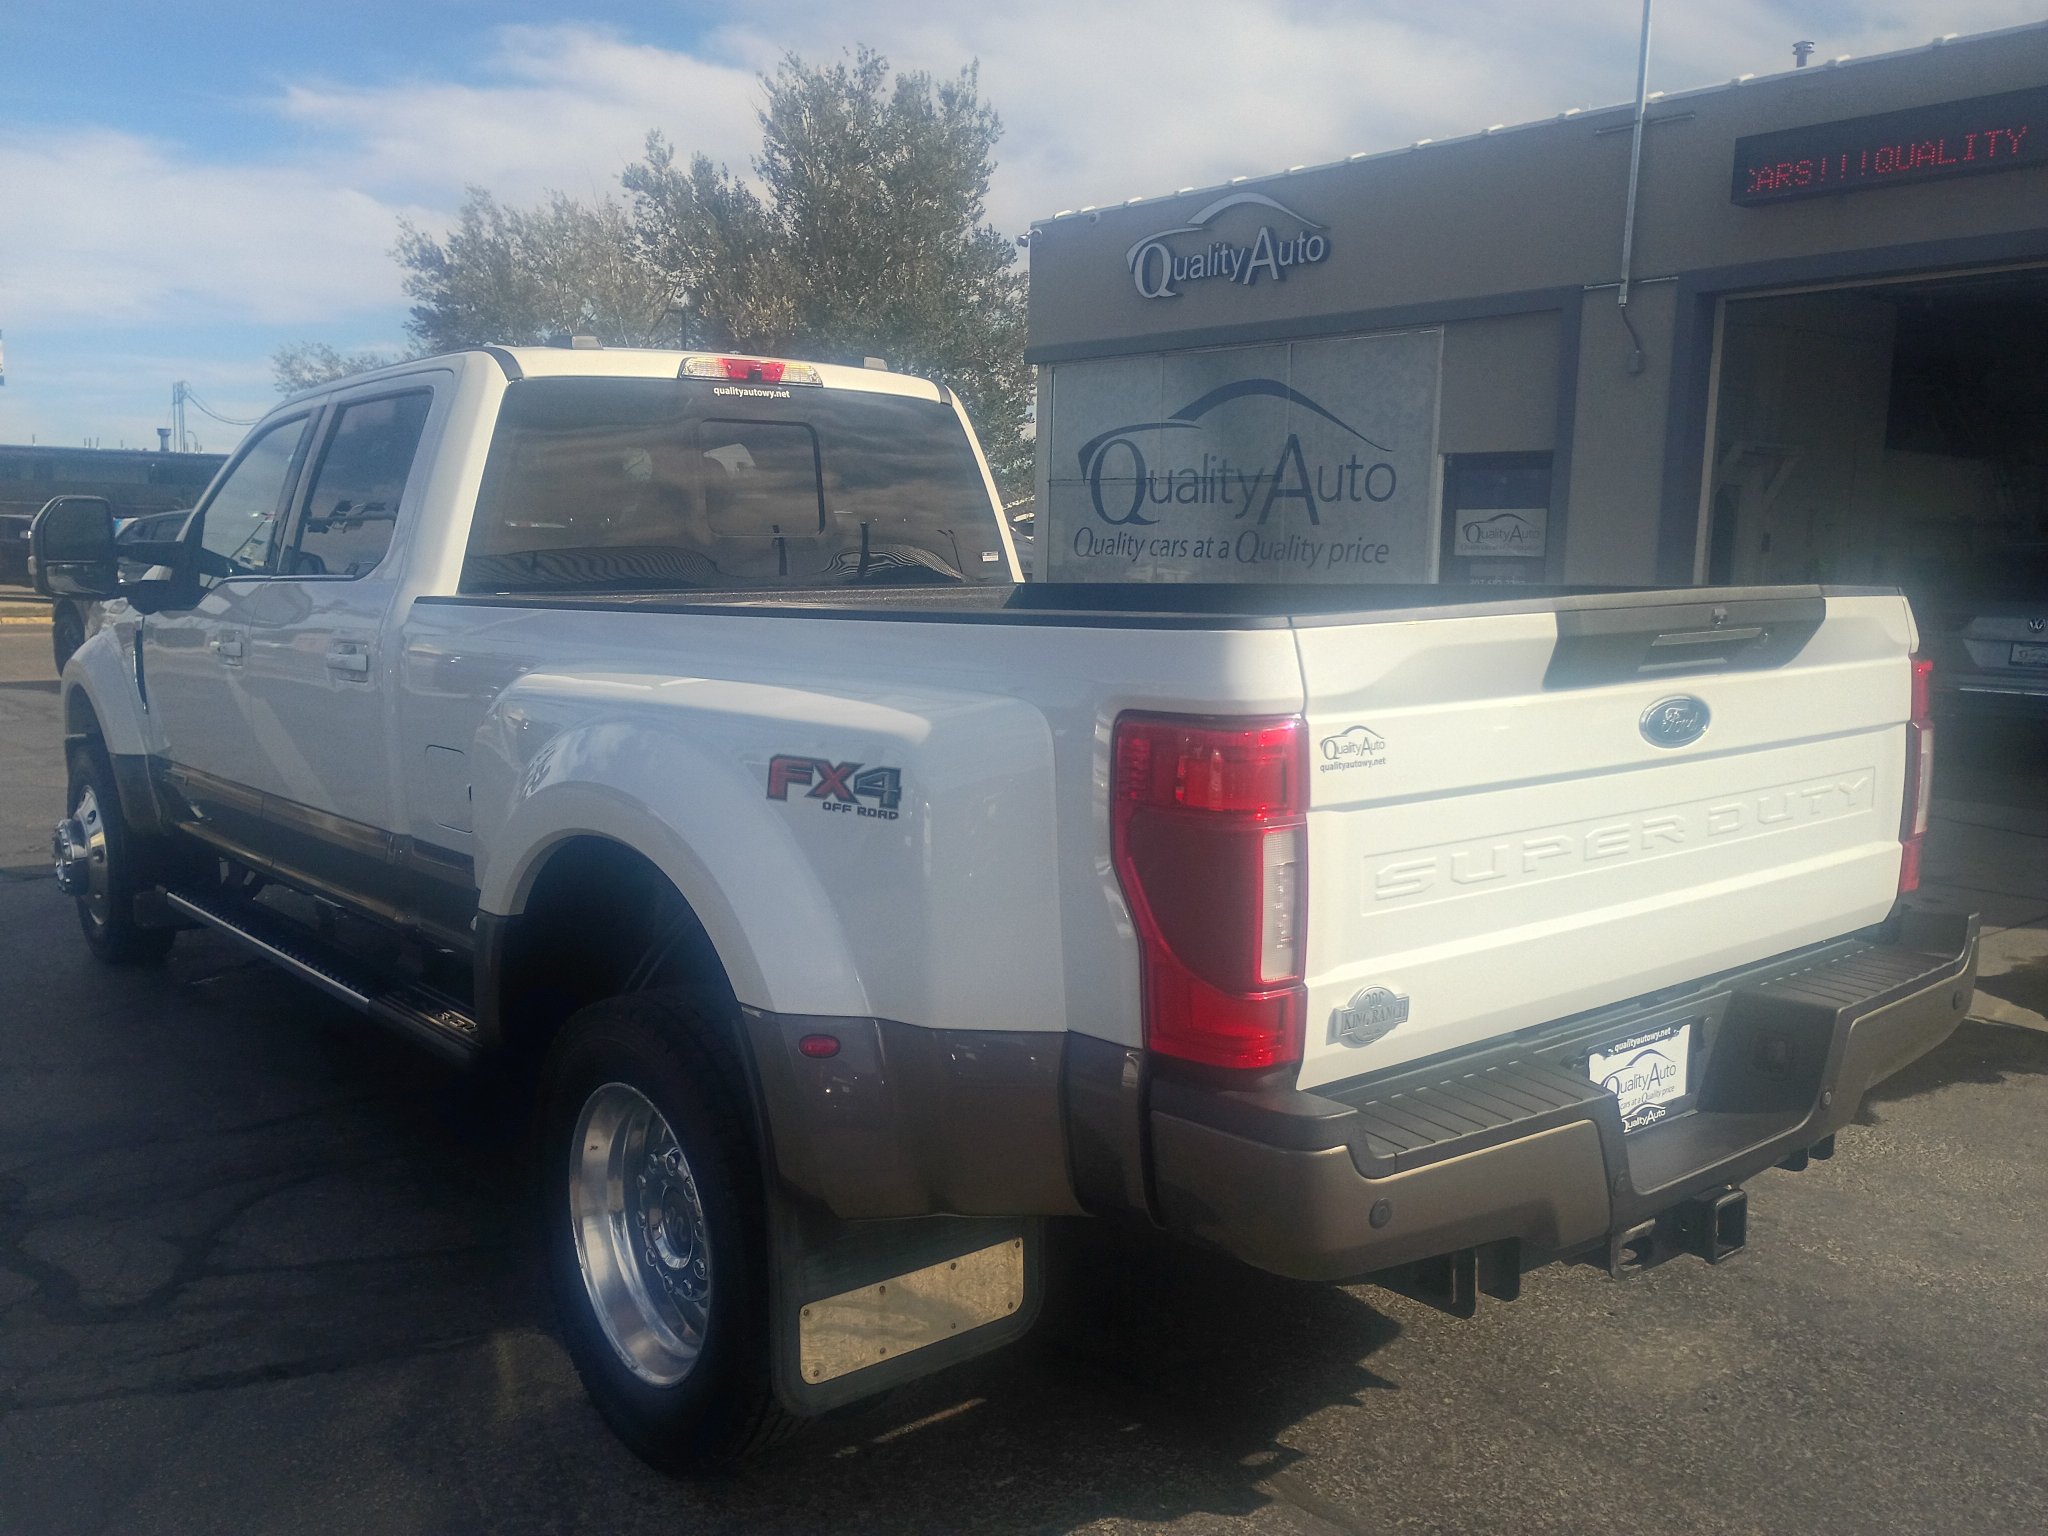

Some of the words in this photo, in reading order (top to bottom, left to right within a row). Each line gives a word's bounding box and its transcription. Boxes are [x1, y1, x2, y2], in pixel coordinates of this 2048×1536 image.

[713, 386, 790, 399] qualityautowy.net
[1073, 527, 1146, 562] Quality
[1149, 538, 1188, 558] cars
[1193, 538, 1213, 559] at
[1217, 540, 1229, 559] a
[1235, 529, 1324, 569] Quality
[1327, 537, 1389, 569] price
[1320, 757, 1386, 772] qualityautowy.net
[766, 753, 903, 810] FX4
[822, 801, 852, 814] OFF
[857, 806, 899, 821] ROAD
[1375, 813, 1686, 901] SUPER
[1707, 776, 1871, 837] DUTY
[1342, 1011, 1369, 1031] KING
[1372, 1001, 1406, 1024] RANCH
[1614, 1027, 1671, 1053] qualityautowy.net
[1662, 1085, 1675, 1097] price
